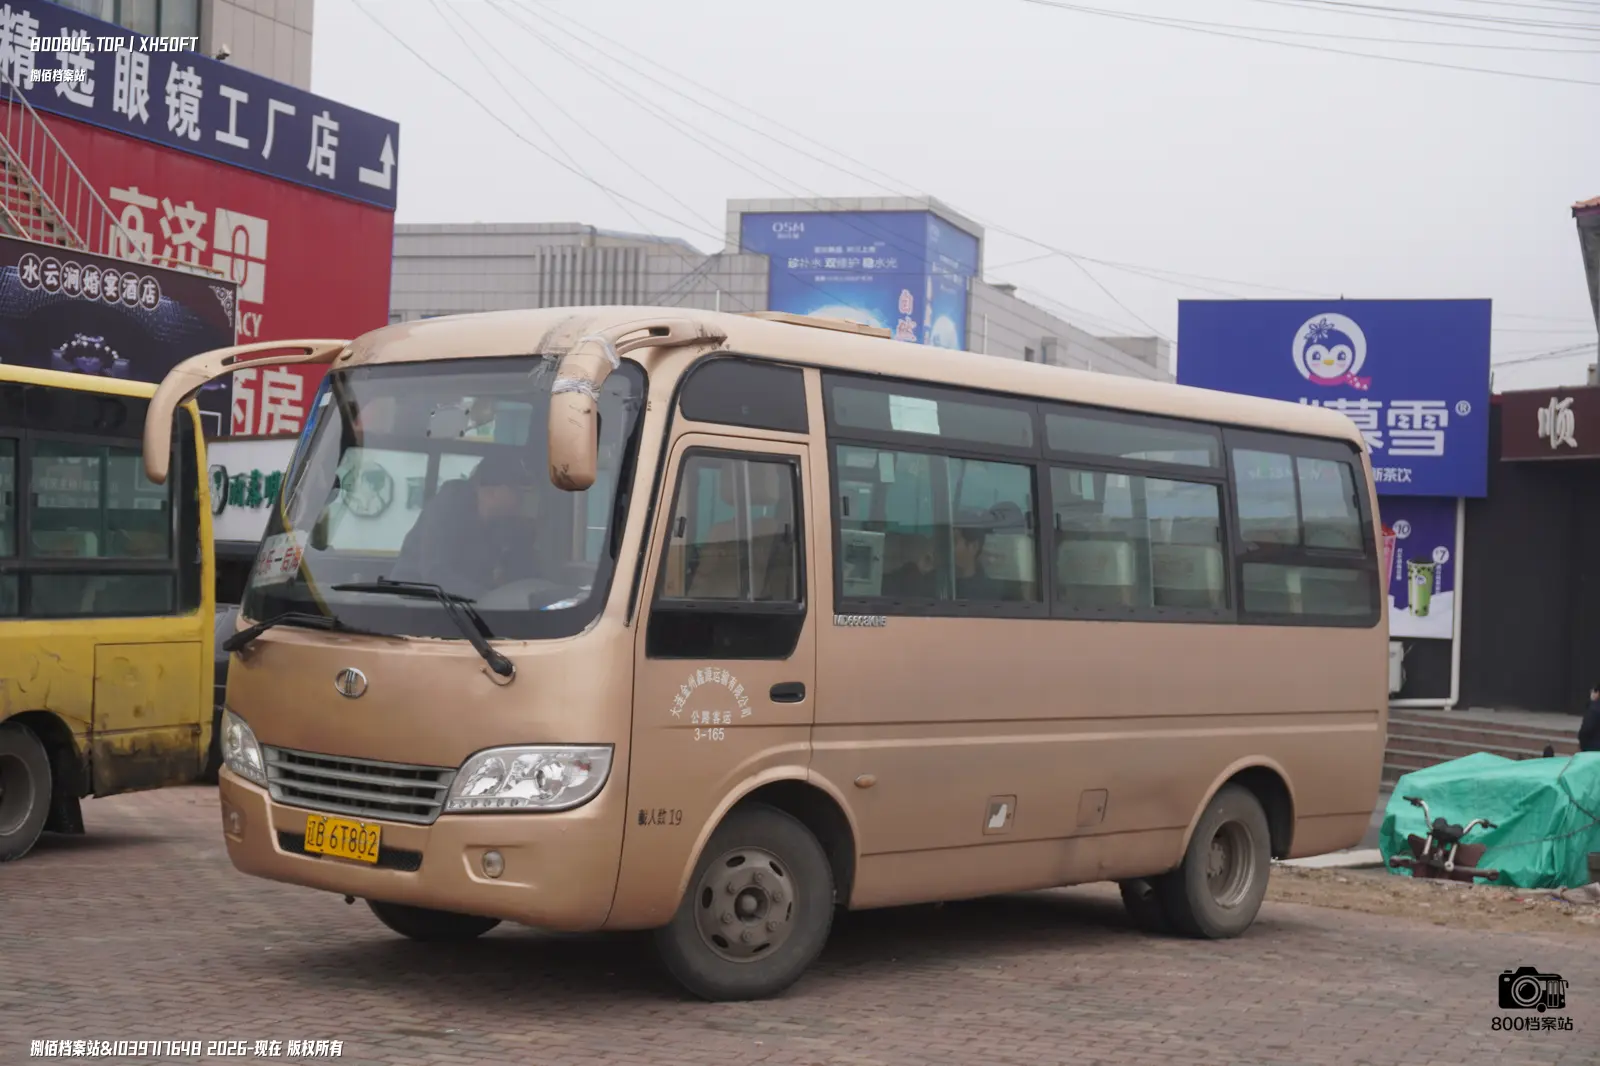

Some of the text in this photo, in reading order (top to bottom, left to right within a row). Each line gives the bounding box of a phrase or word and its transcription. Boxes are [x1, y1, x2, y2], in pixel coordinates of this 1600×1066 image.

[0, 3, 340, 180] 精选眼镜工厂店
[22, 256, 158, 306] 水云涧婚宴酒店
[1299, 397, 1449, 457] 慕雪
[1537, 396, 1578, 449] 顺
[690, 710, 732, 725] 公路客运
[693, 727, 725, 741] 3-165
